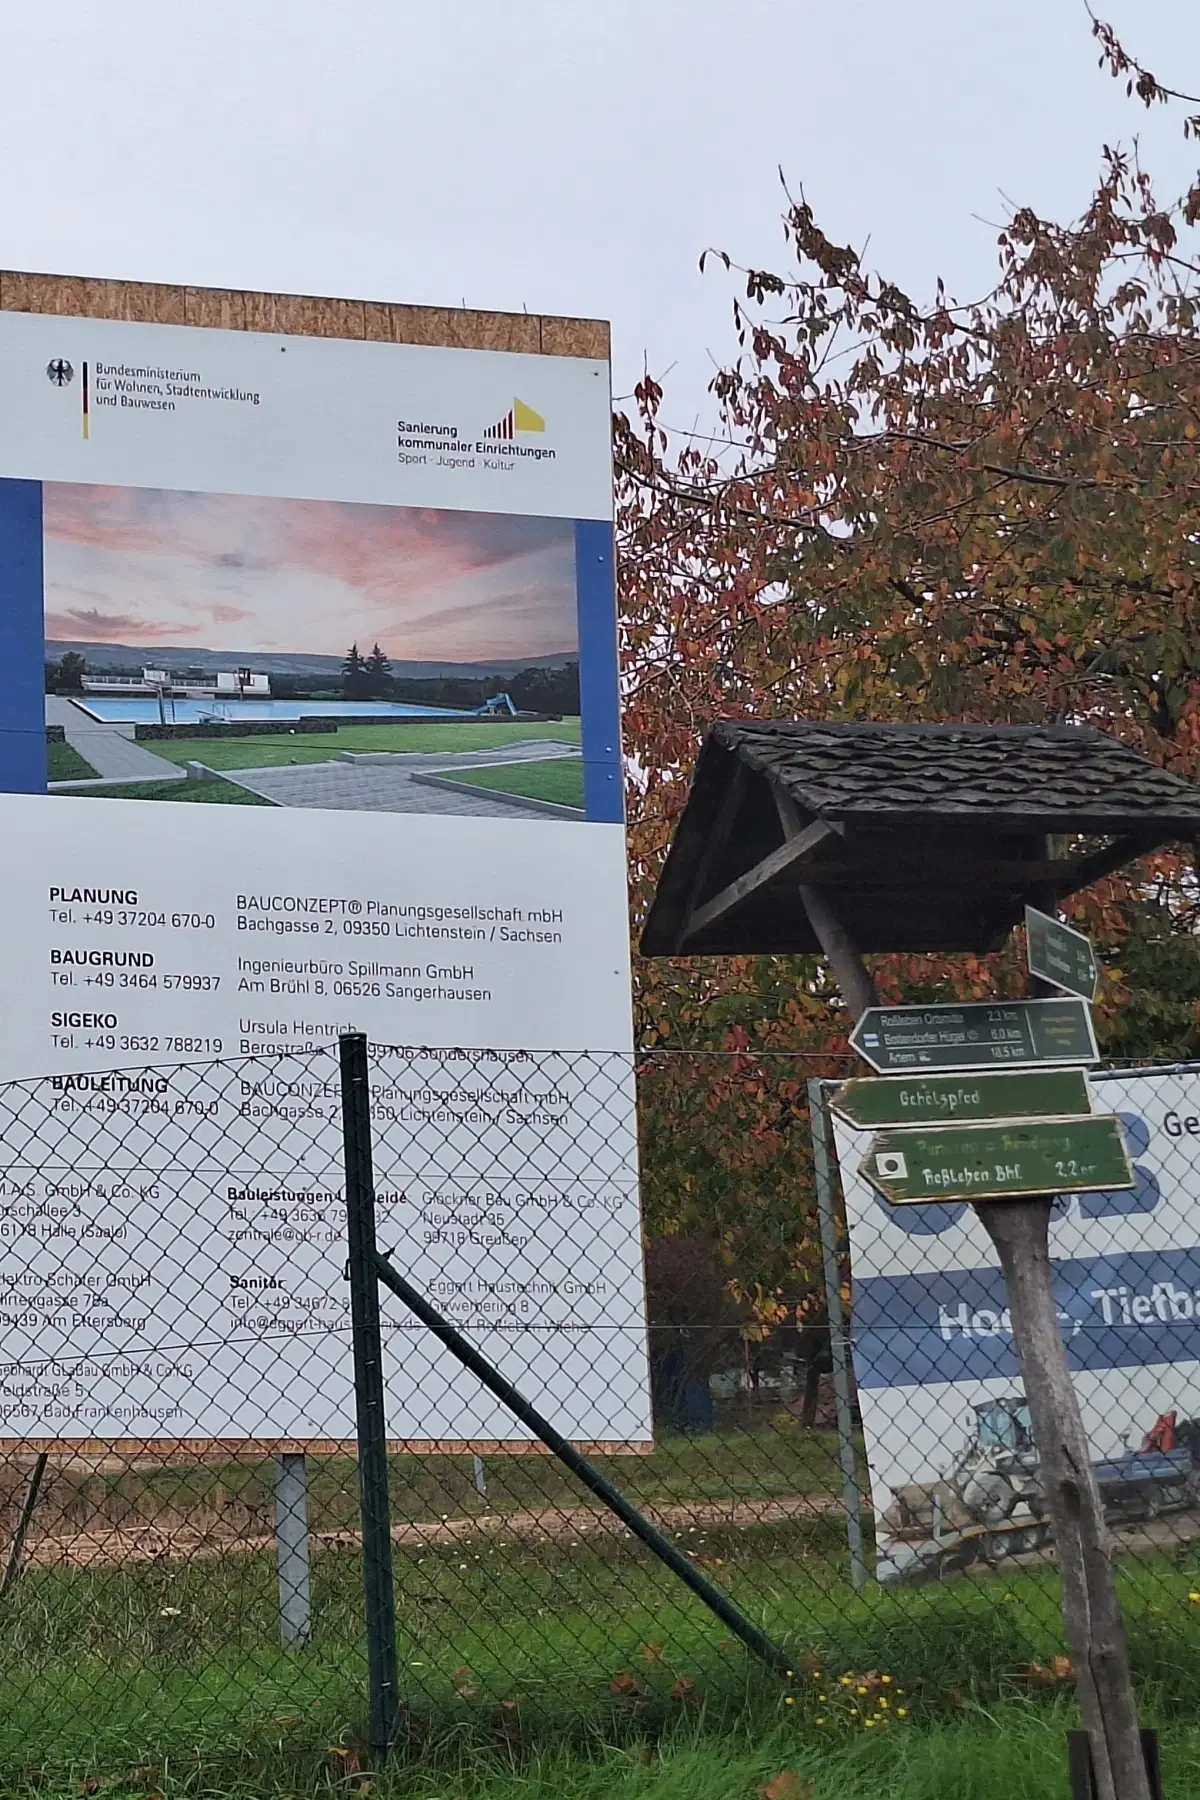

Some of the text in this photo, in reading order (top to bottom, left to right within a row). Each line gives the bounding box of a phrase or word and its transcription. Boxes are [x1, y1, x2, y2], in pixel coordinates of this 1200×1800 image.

[95, 361, 201, 382] Bundesministerium
[96, 376, 260, 405] für Wohnen, Stadtentwicklung
[95, 395, 176, 411] und Bauwesen
[397, 420, 458, 439] Sanierung
[397, 435, 556, 460] kommunaler Einrichtungen
[398, 452, 516, 471] Sport Jugend Kultur
[49, 886, 138, 906] PLANUNG
[48, 908, 215, 929] Tel. +49 37204 670-0
[366, 900, 523, 922] Planungsgesellschaft
[527, 908, 563, 924] mbH
[237, 915, 562, 944] Bachgasse 2, 09350 Lichtenstein Sachsen
[50, 949, 154, 968] BAUGRUND
[238, 956, 474, 980] Ingenieurbüro Spillmann GmbH
[49, 970, 221, 992] Tel. +49 3464 579937
[237, 977, 492, 1003] Am Brühl 8, 06526 Sangerhausen
[51, 1011, 118, 1029] SIGEKO
[239, 1017, 288, 1035] Ursula
[49, 1033, 223, 1054] Tel. +49 3632 788219
[52, 1076, 169, 1094] BAULEITUNG
[45, 1184, 91, 1198] GmbH
[141, 1185, 160, 1199] KG
